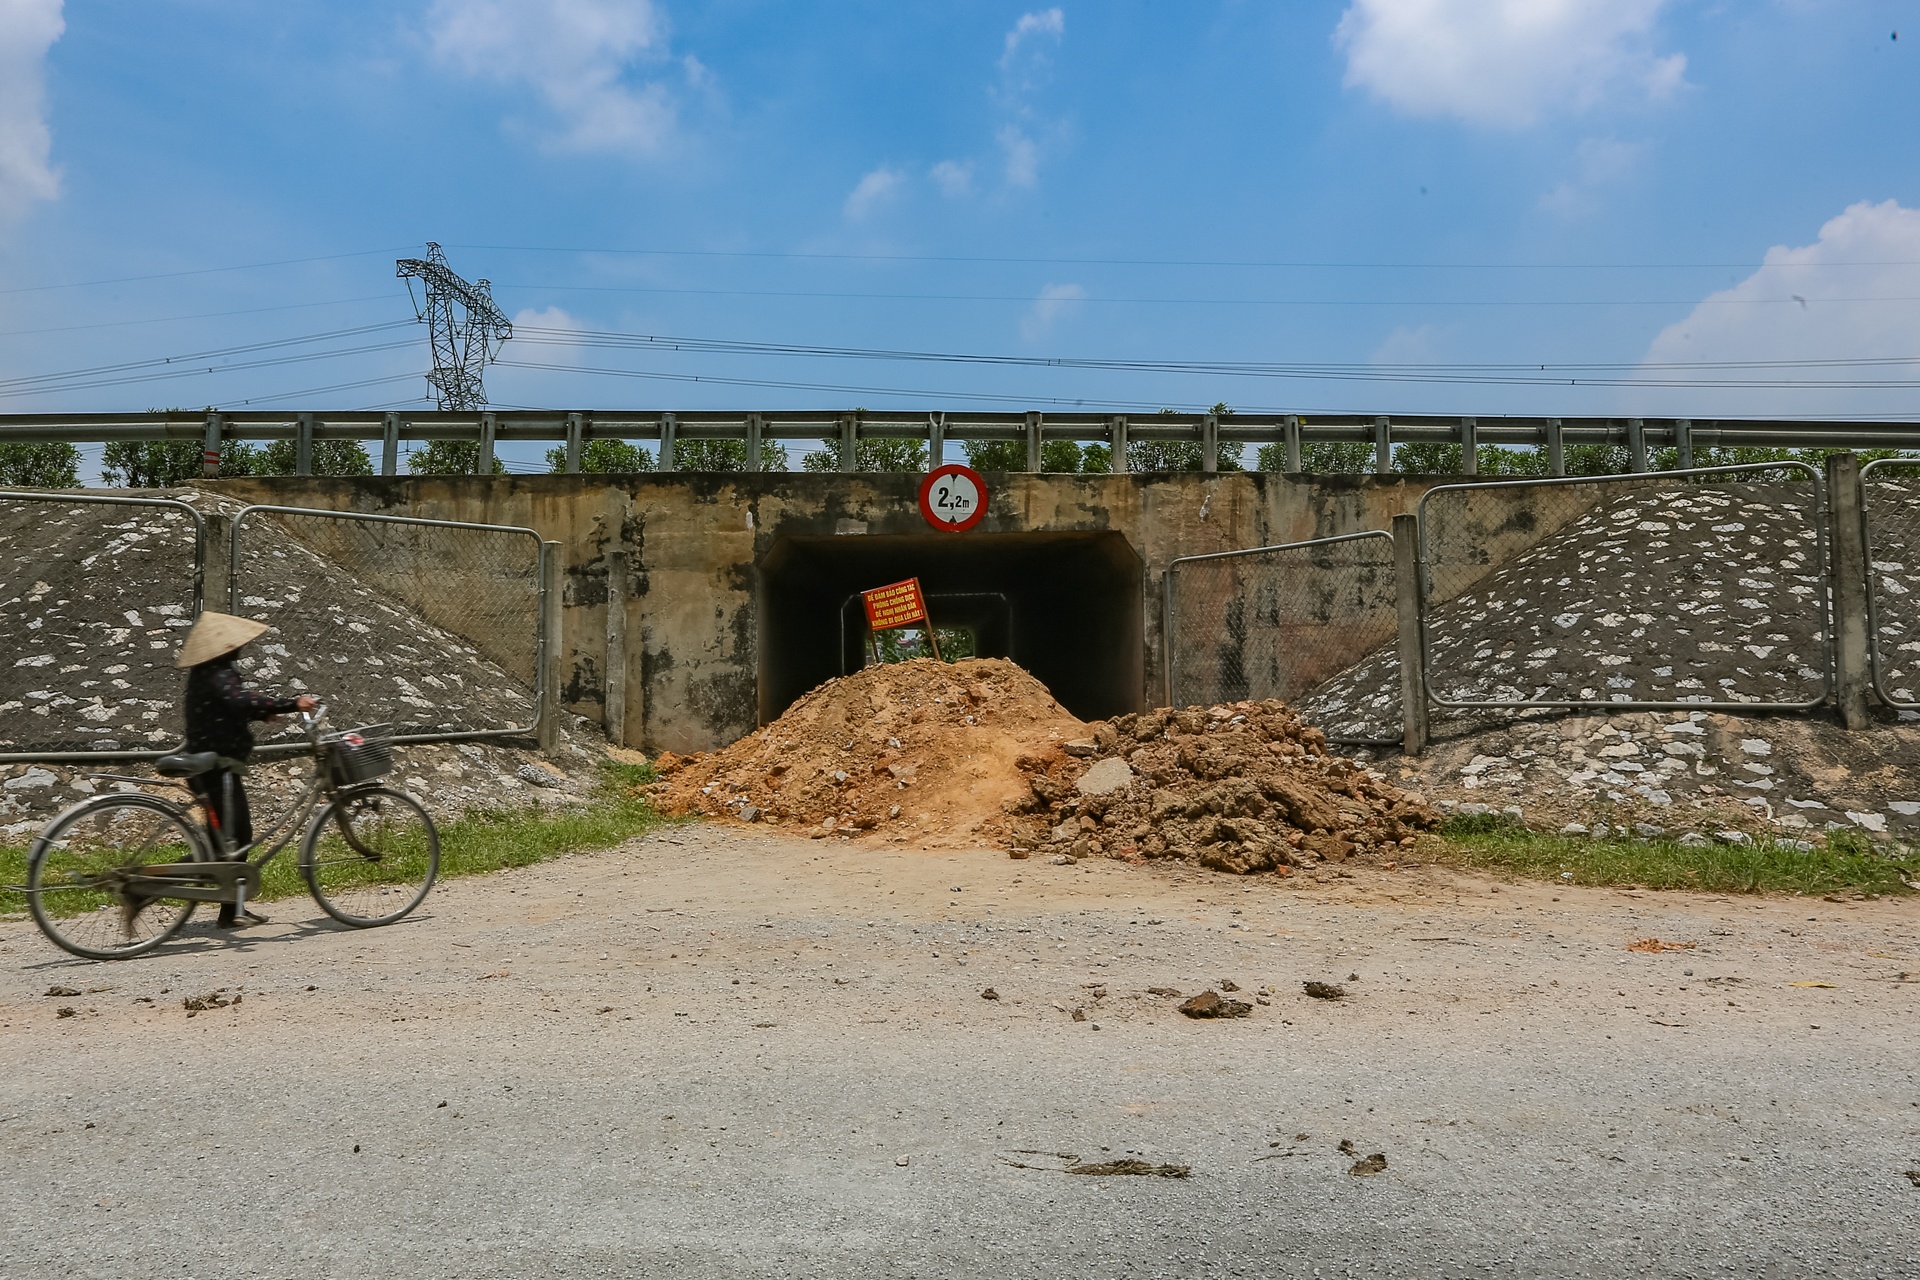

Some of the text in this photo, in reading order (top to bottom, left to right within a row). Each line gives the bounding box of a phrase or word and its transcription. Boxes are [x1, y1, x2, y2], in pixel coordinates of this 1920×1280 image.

[938, 487, 969, 510] 2,2m
[896, 586, 907, 594] CÔNG
[872, 618, 888, 626] KHÔNG
